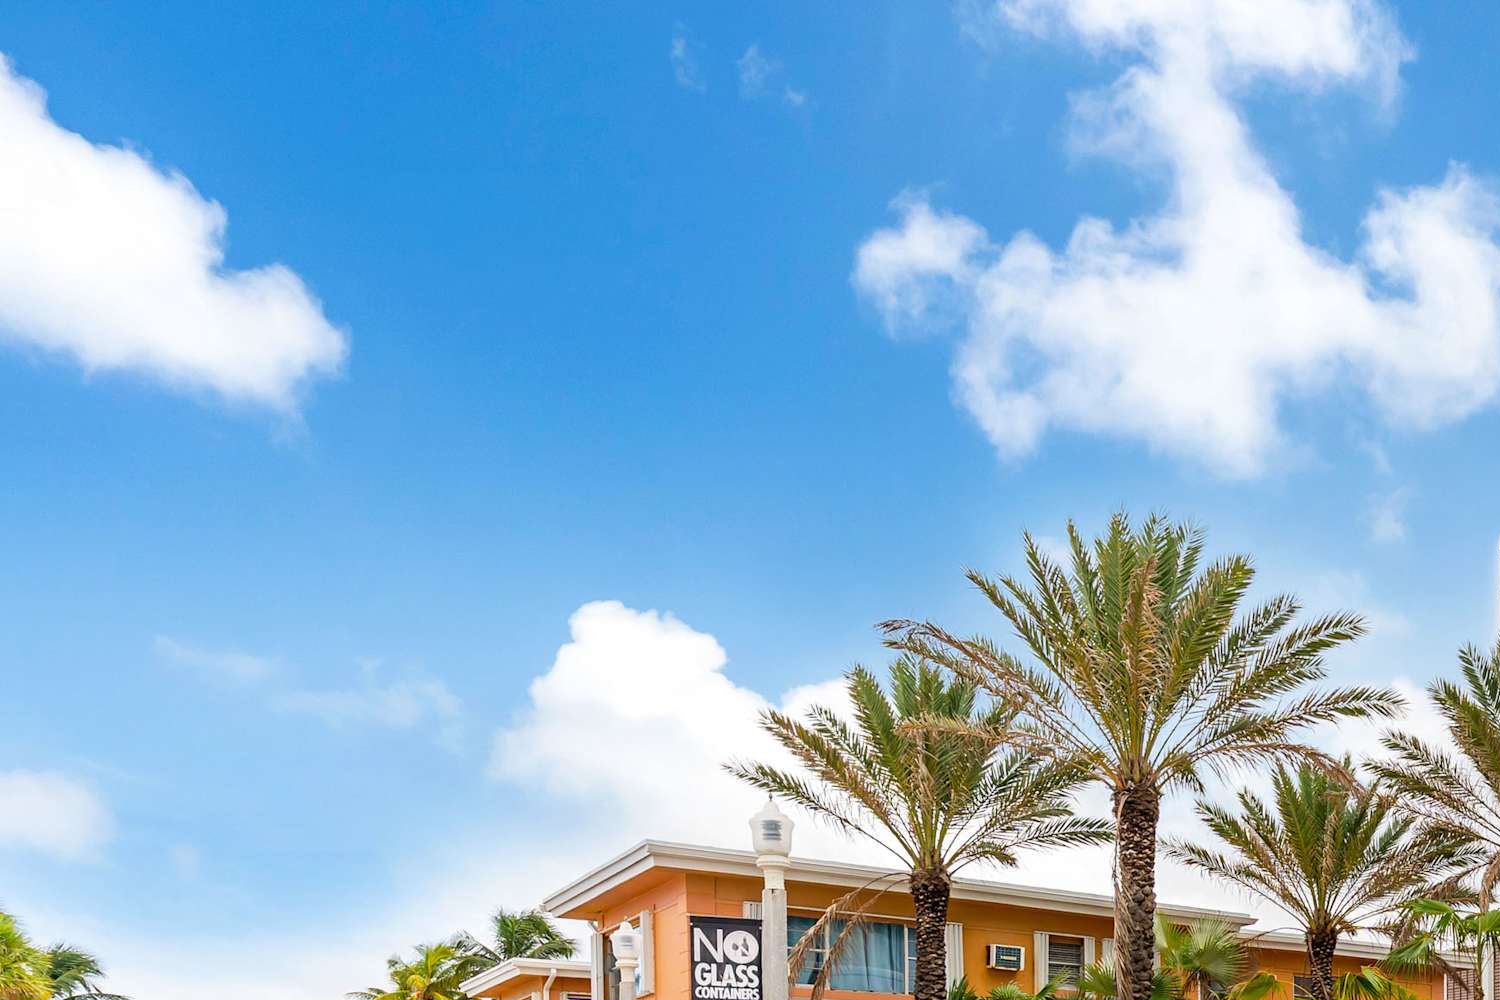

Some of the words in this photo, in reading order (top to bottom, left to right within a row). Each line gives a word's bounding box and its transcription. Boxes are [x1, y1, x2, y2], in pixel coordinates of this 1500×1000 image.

[694, 927, 759, 964] NO
[695, 962, 760, 988] GLASS
[695, 986, 760, 1000] CONTAINERS
